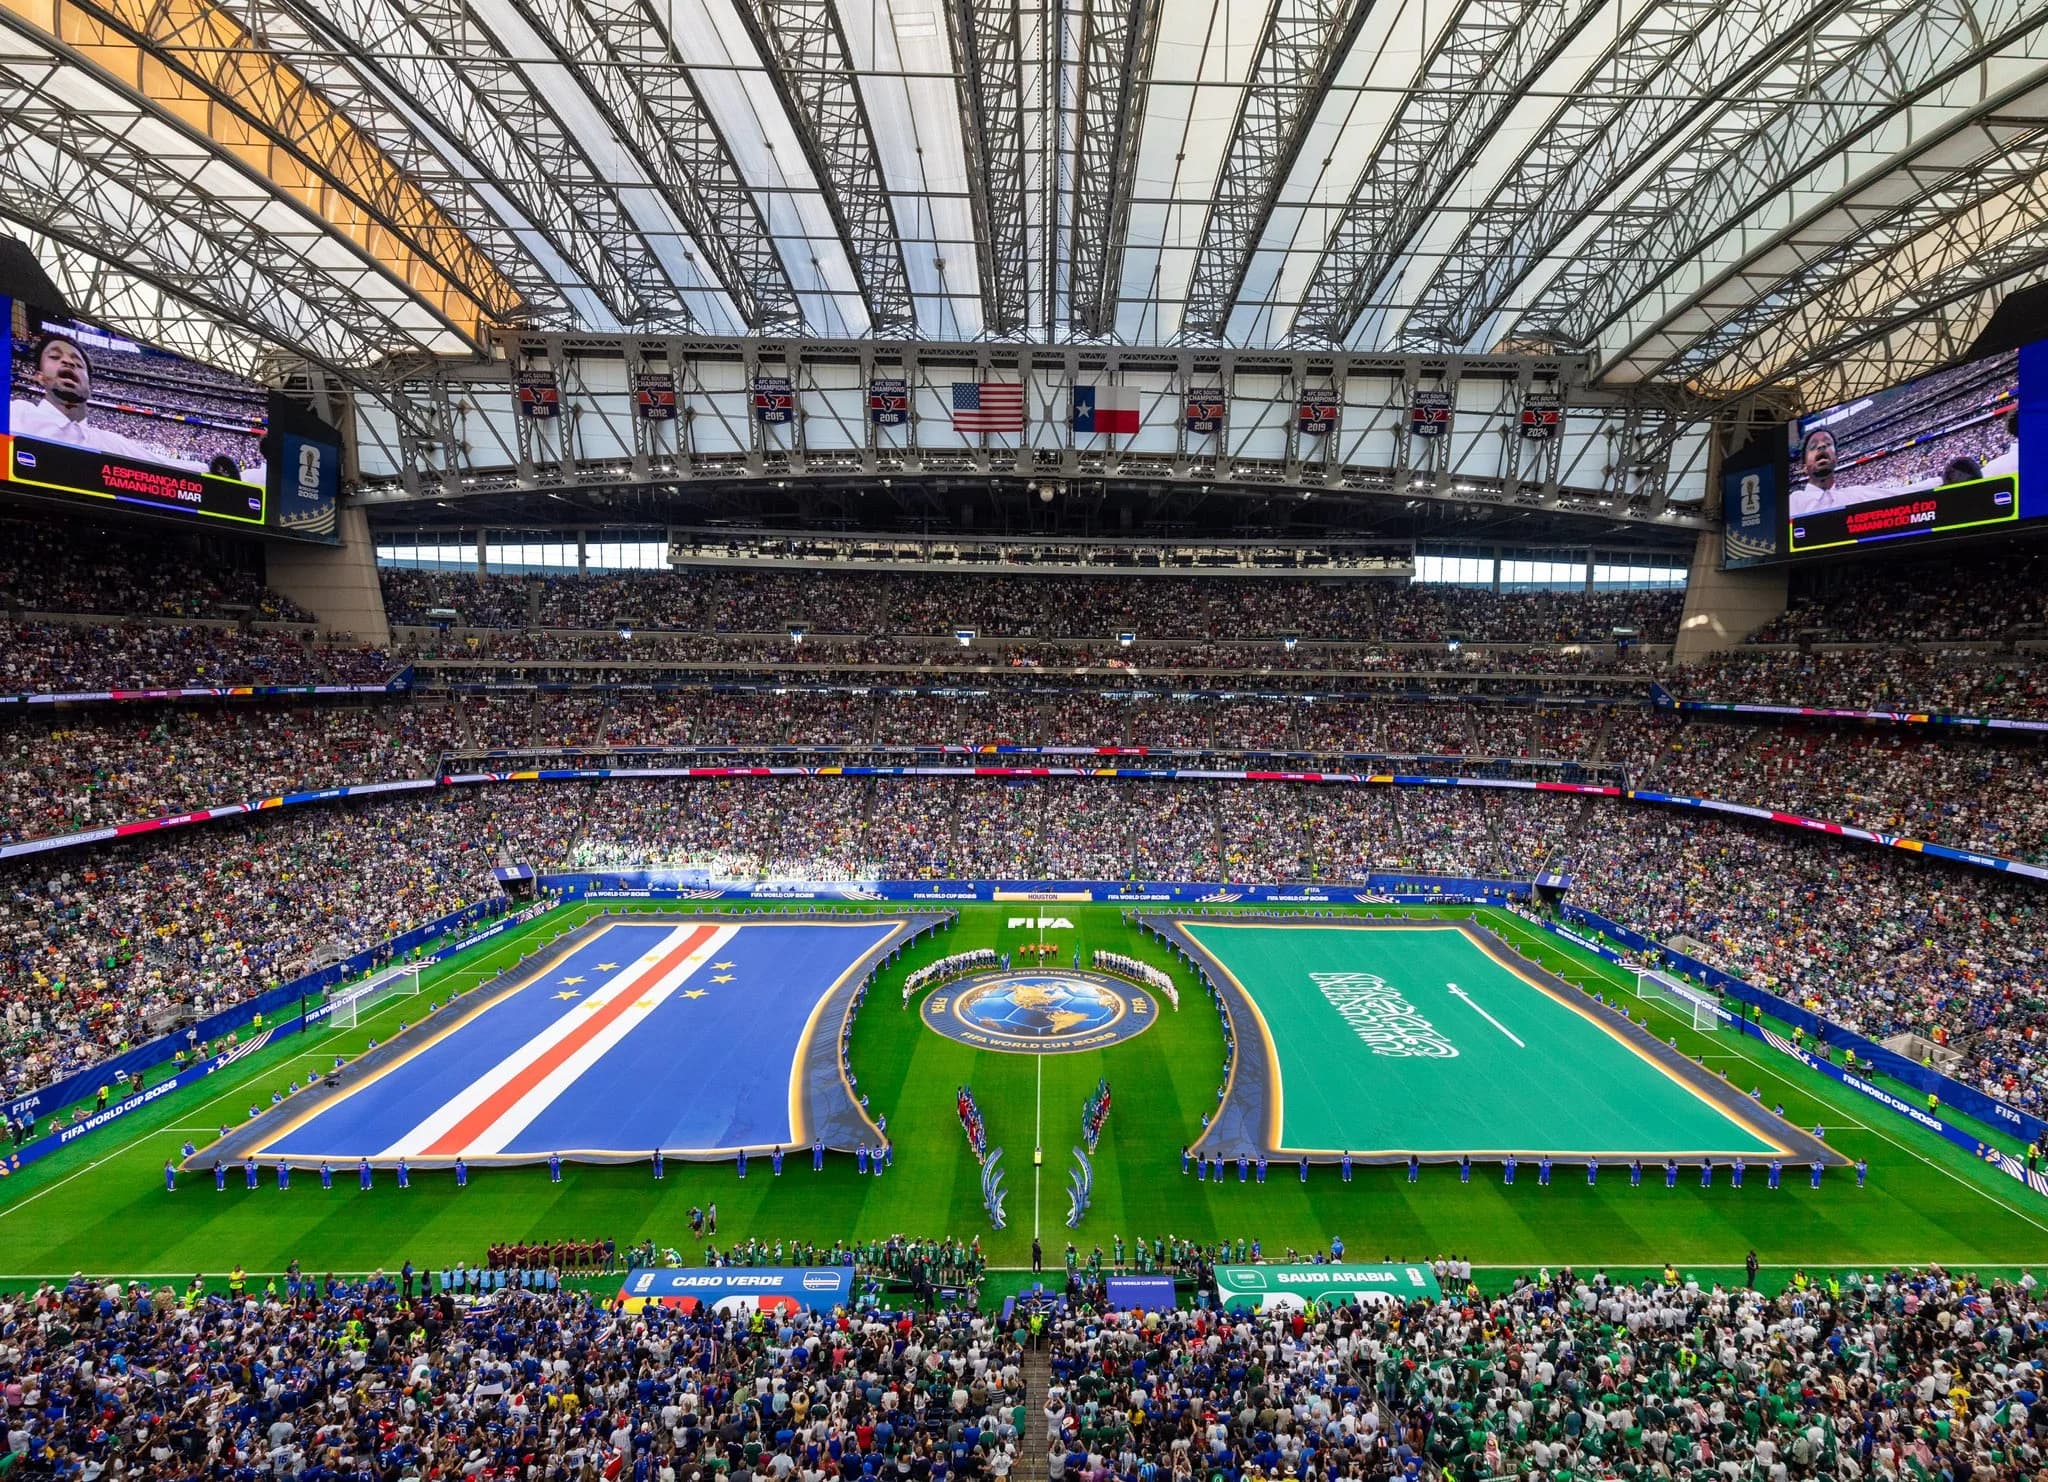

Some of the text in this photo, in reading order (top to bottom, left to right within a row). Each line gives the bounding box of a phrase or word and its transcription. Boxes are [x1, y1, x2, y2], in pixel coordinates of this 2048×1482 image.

[532, 405, 549, 415] 2011
[648, 408, 668, 418] 2012
[765, 411, 785, 421] 2015
[879, 413, 899, 422] 2016
[1194, 421, 1213, 430] 2018
[1307, 422, 1327, 432] 2019
[1420, 425, 1438, 434] 2023
[1527, 427, 1549, 437] 2024
[101, 464, 203, 493] A ESPERANÇA É DO
[102, 475, 202, 503] TAMANHO DO MAR
[1846, 515, 1854, 524] A
[1912, 501, 1920, 513] É
[1920, 501, 1937, 511] DO
[1894, 516, 1910, 526] DO
[1910, 511, 1936, 524] MAR
[1007, 917, 1075, 929] FIFA
[305, 1010, 320, 1023] FIFA
[319, 1000, 342, 1016] WORLD
[930, 997, 949, 1014] FIFA
[1131, 997, 1148, 1014] FIFA
[960, 1031, 987, 1043] FIFA
[989, 1038, 1040, 1049] WORLD
[1071, 1032, 1118, 1047] 2026
[12, 1096, 40, 1115] FIFA
[1842, 1073, 1943, 1132] FIFA WORLD CUP 2026
[61, 1079, 178, 1143] FIFA WORLD CUP 2026
[1994, 1104, 2022, 1125] FIFA
[671, 1276, 785, 1287] CABO VERDE
[1277, 1272, 1398, 1283] SAUDI ARABIA
